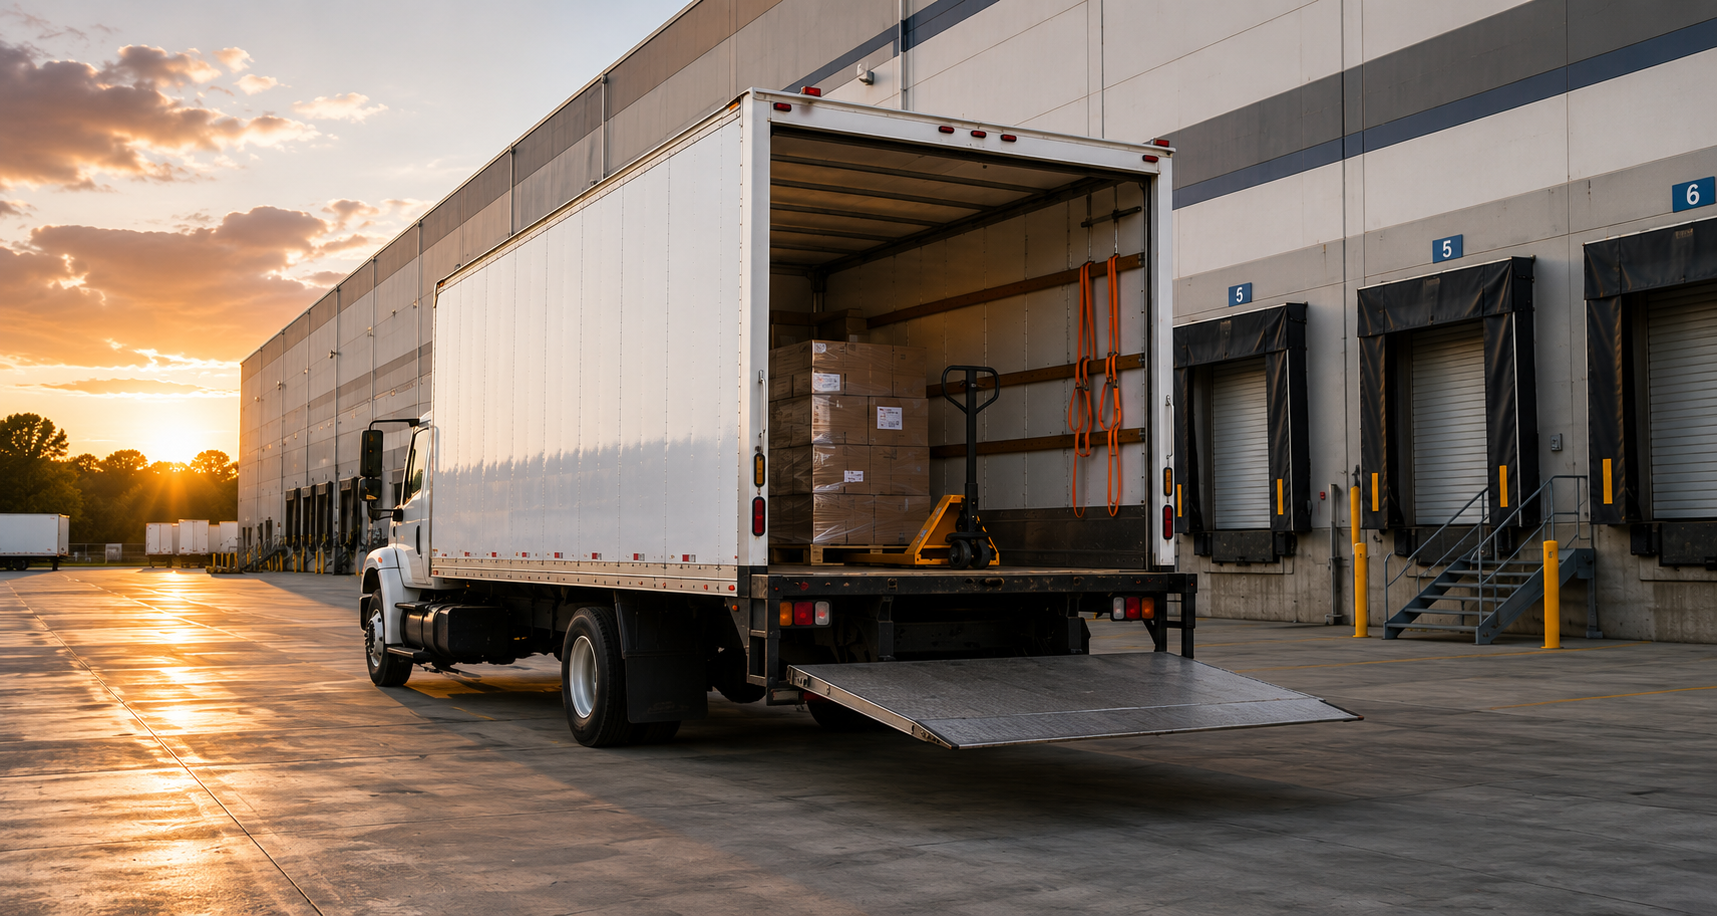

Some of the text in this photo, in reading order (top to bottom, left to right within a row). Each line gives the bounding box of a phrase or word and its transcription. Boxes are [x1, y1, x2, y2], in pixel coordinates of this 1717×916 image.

[1686, 183, 1700, 205] 6
[1442, 239, 1452, 258] 5
[1236, 286, 1244, 303] 5
